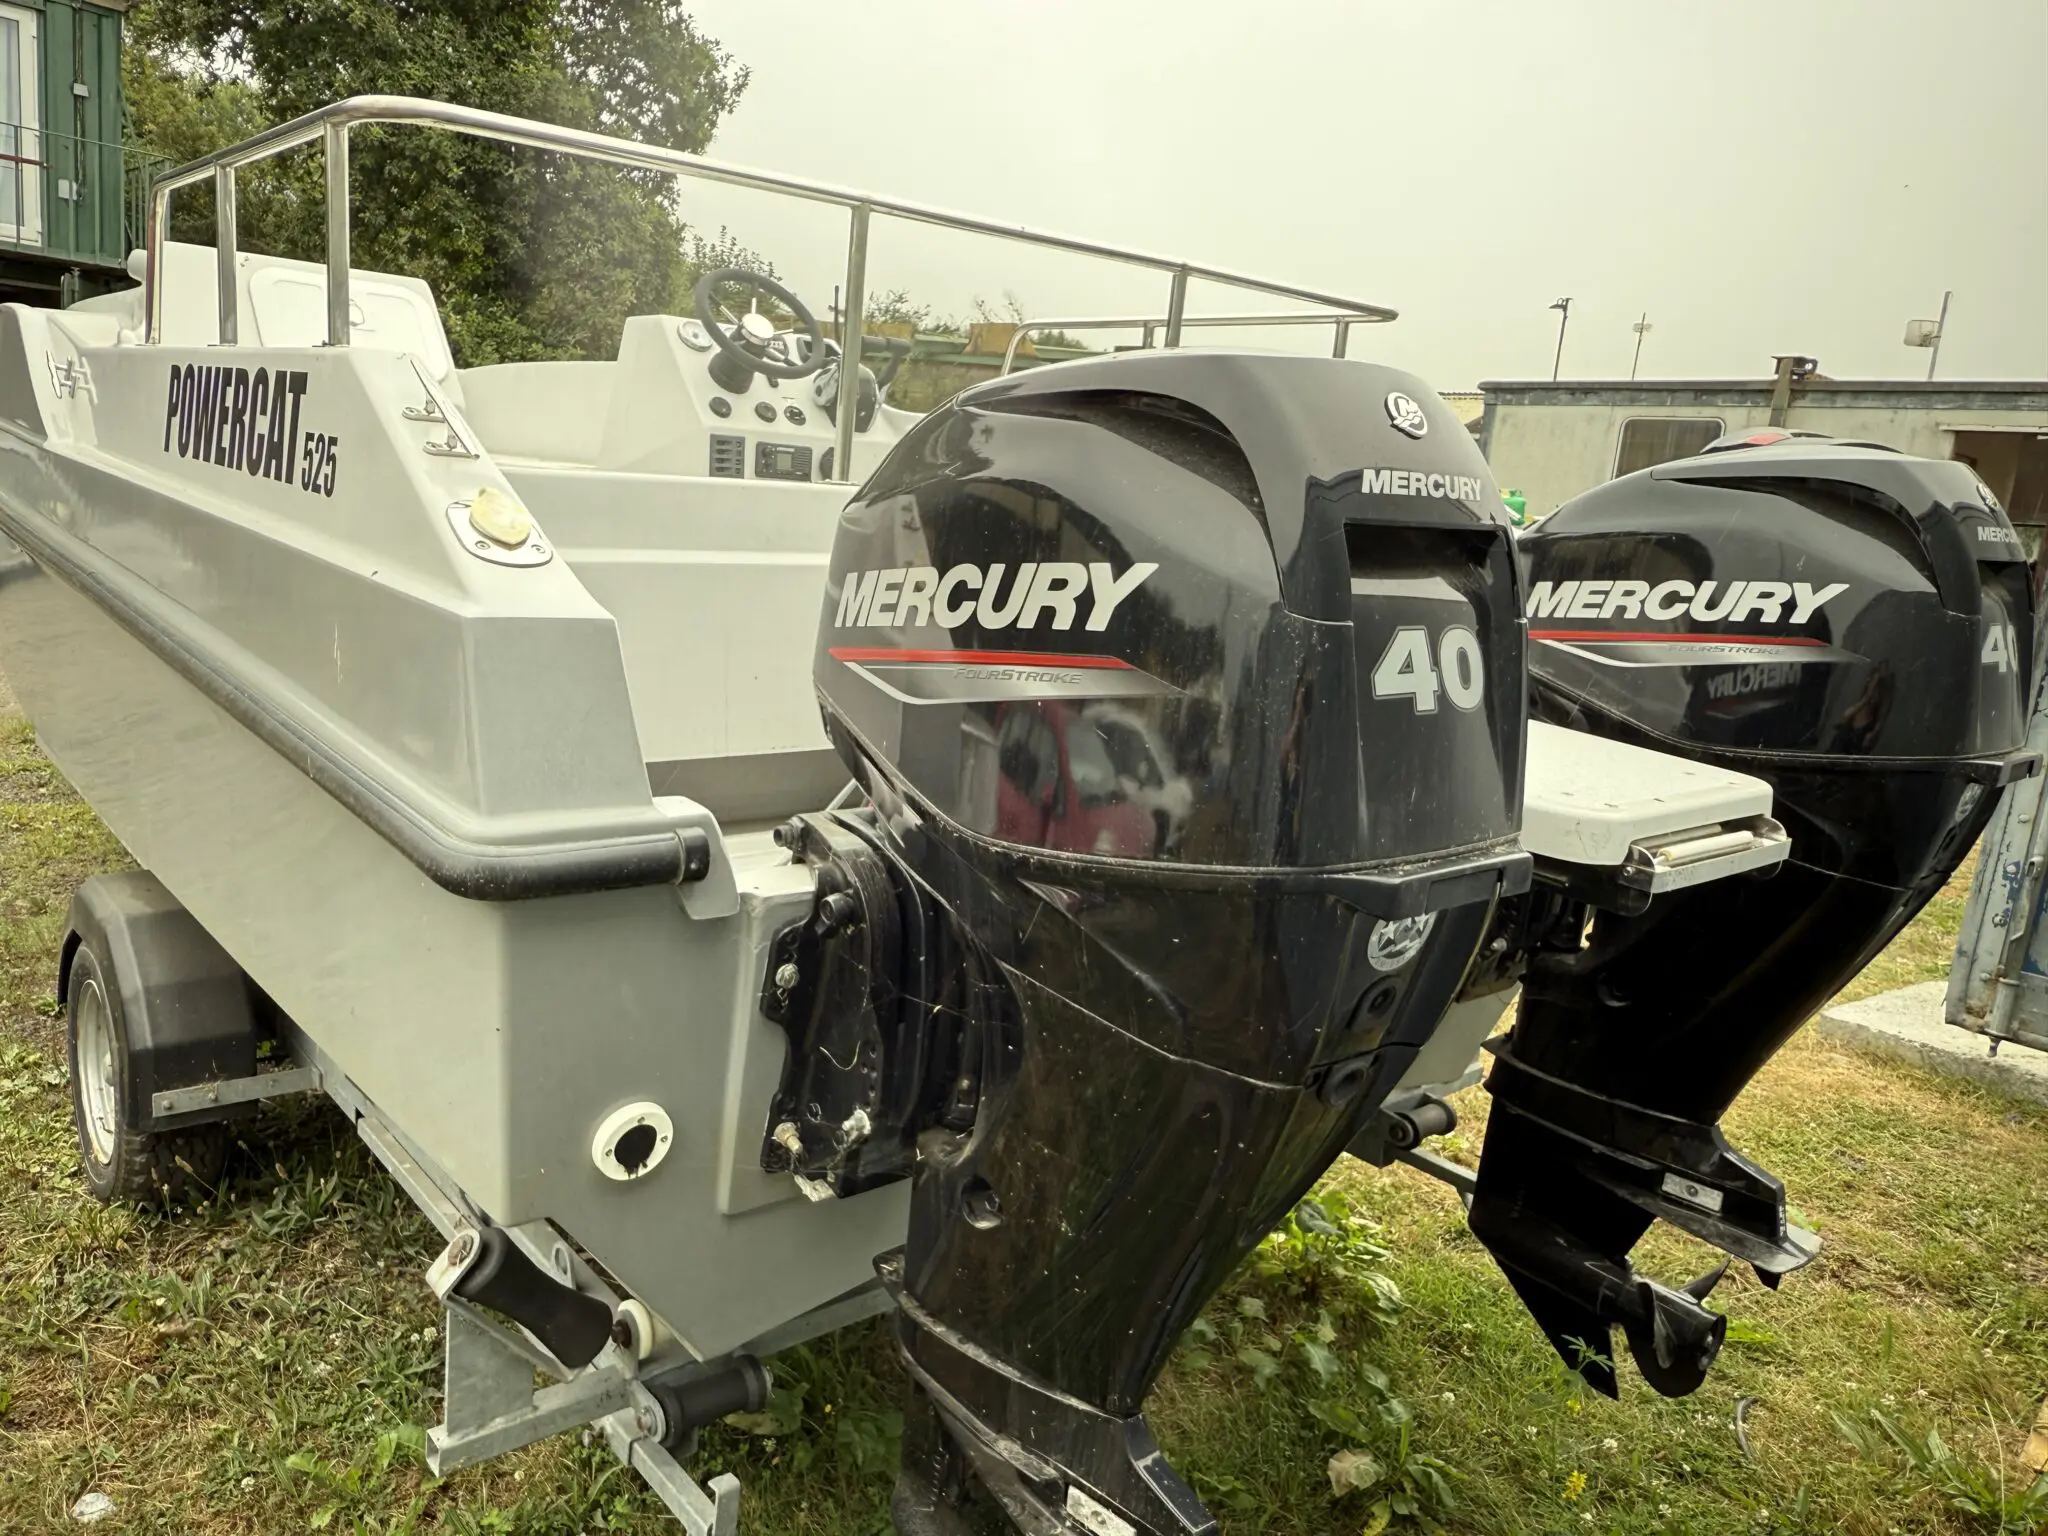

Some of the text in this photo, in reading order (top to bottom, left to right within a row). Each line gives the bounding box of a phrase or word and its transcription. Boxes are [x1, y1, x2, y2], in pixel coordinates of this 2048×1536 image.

[164, 363, 338, 498] POWERCAT 525
[1361, 468, 1481, 501] MERCURY
[834, 563, 1160, 631] MERCURY
[1526, 580, 1850, 624] MERCURY
[1371, 624, 1485, 715] 40
[1981, 624, 2018, 673] 40
[953, 668, 1082, 684] FOURSTROKE
